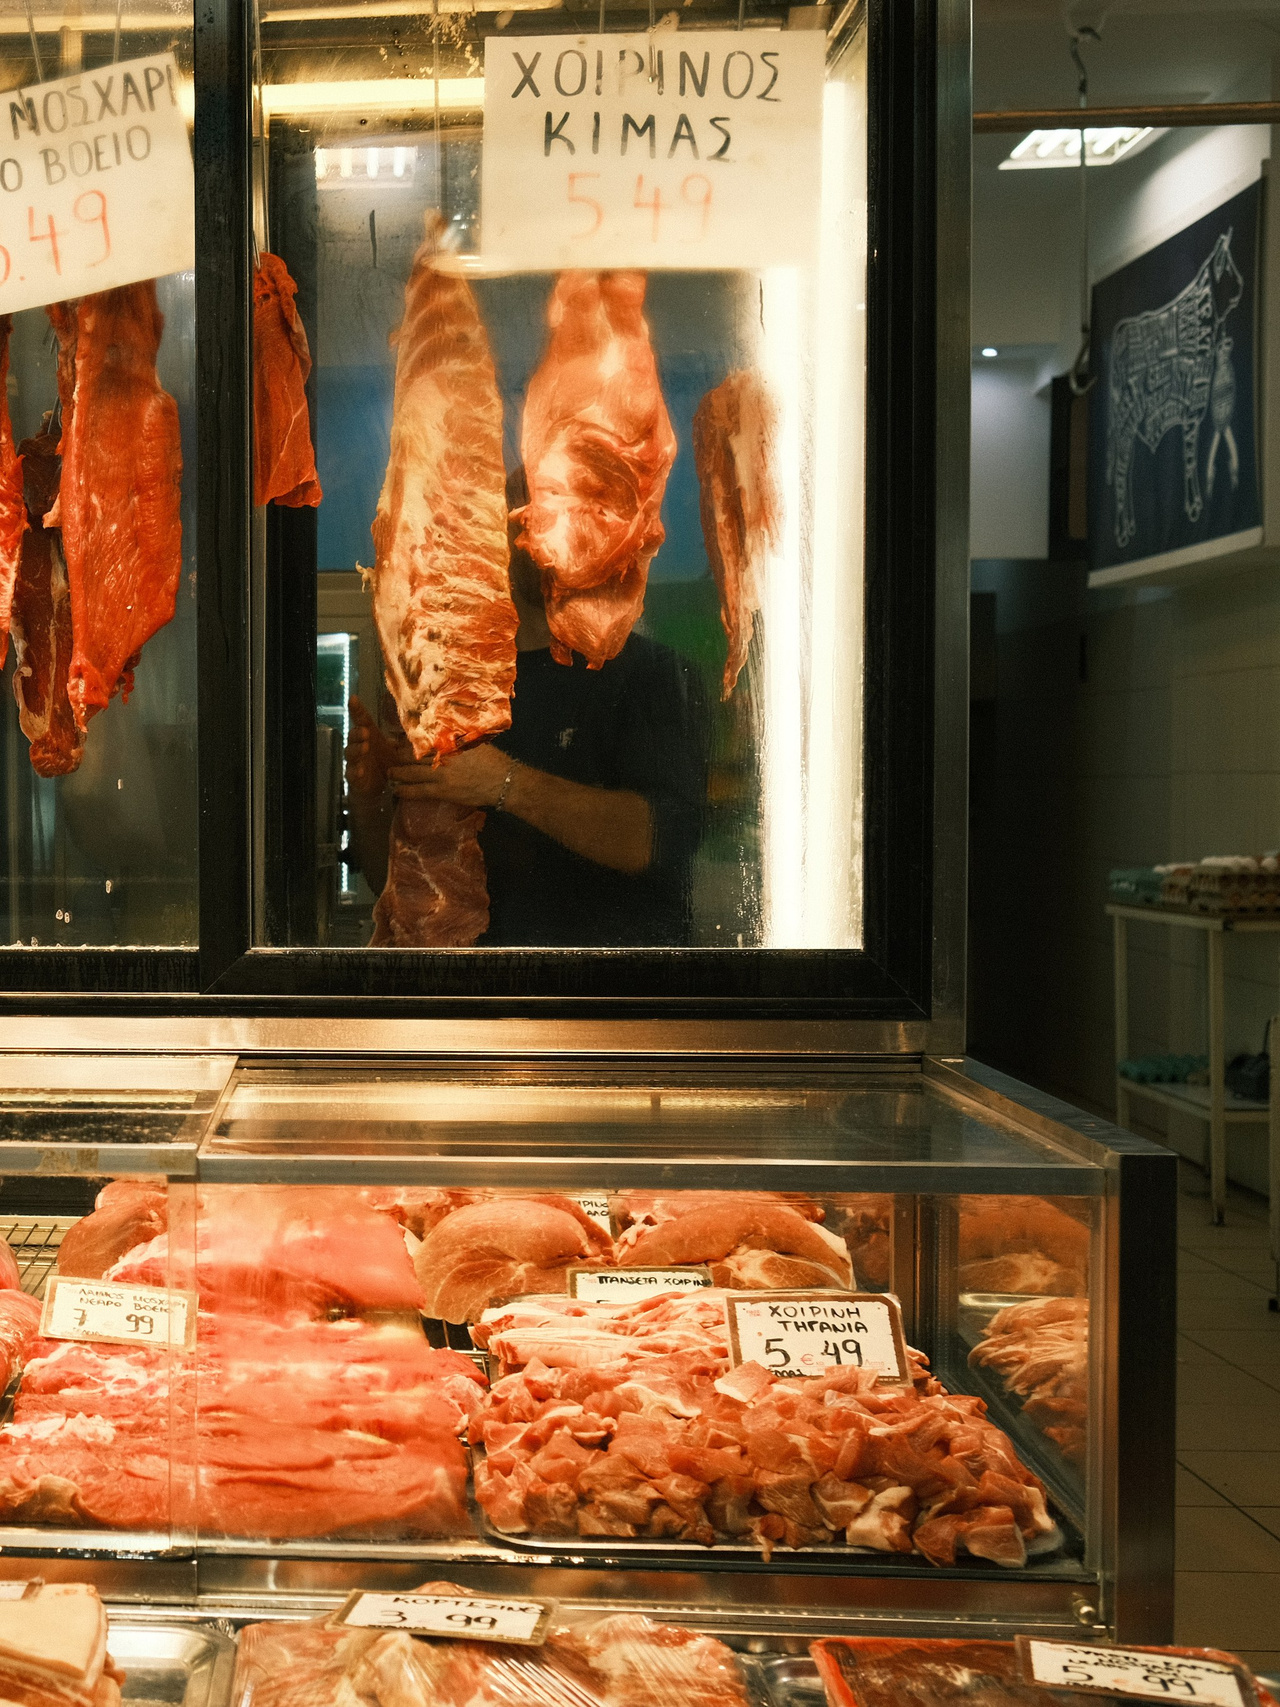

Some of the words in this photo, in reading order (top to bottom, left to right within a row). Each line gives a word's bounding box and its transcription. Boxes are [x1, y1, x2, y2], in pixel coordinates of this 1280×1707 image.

[510, 50, 781, 102] ΧΟΙΡΙΝΟΣ
[9, 64, 179, 141] ΜΟΣΧΑΡΙ
[39, 125, 151, 186] ΒΟΕΙΟ
[544, 110, 736, 163] ΚΙΜΑΣ
[769, 1305, 861, 1318] ΧΟΙΡΙΝΗ
[778, 1320, 868, 1333] ΤΗΓΑΝΙΑ
[765, 1338, 791, 1368] 5
[821, 1339, 864, 1368] 49
[446, 1613, 498, 1630] 99
